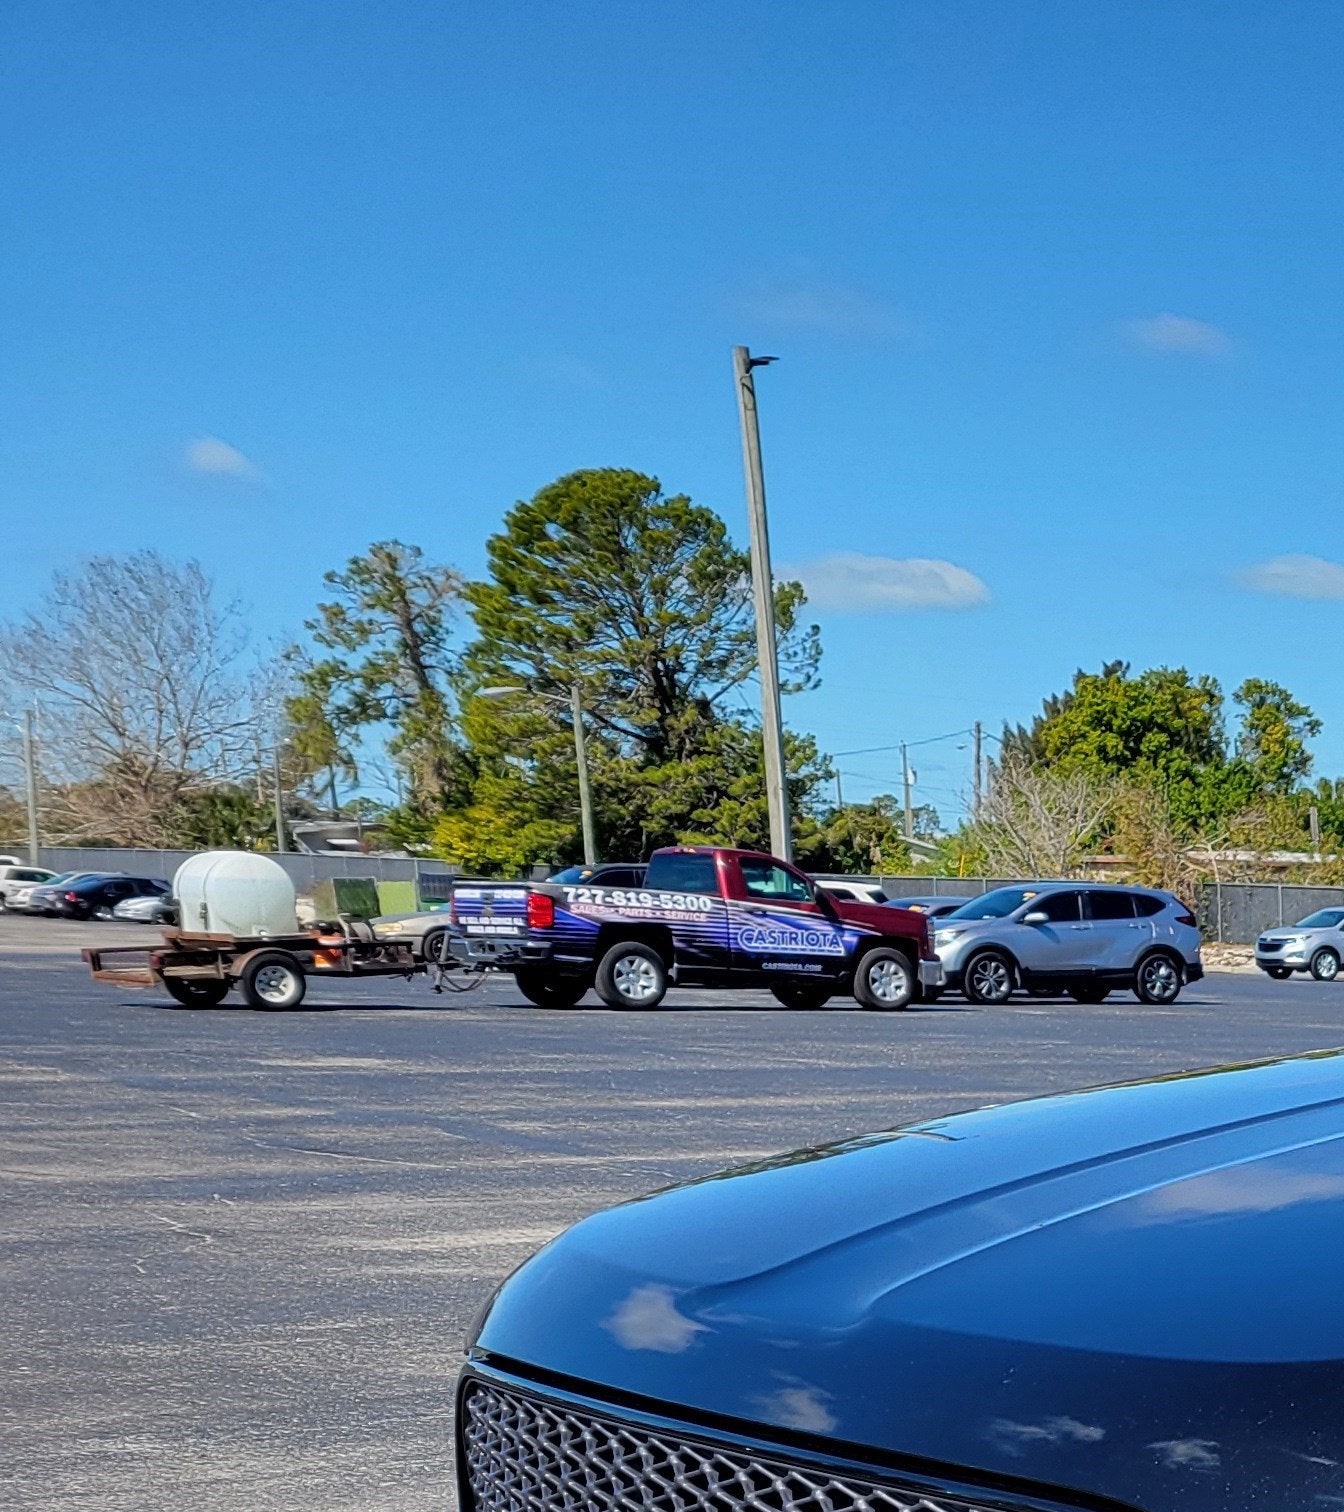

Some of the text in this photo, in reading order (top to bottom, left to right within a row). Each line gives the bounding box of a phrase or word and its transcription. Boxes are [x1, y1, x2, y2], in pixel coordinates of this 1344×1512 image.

[562, 887, 712, 912] 727-819-5300
[569, 904, 708, 922] SALES PARTS SERVICE
[738, 927, 842, 950] CASTRIOTA
